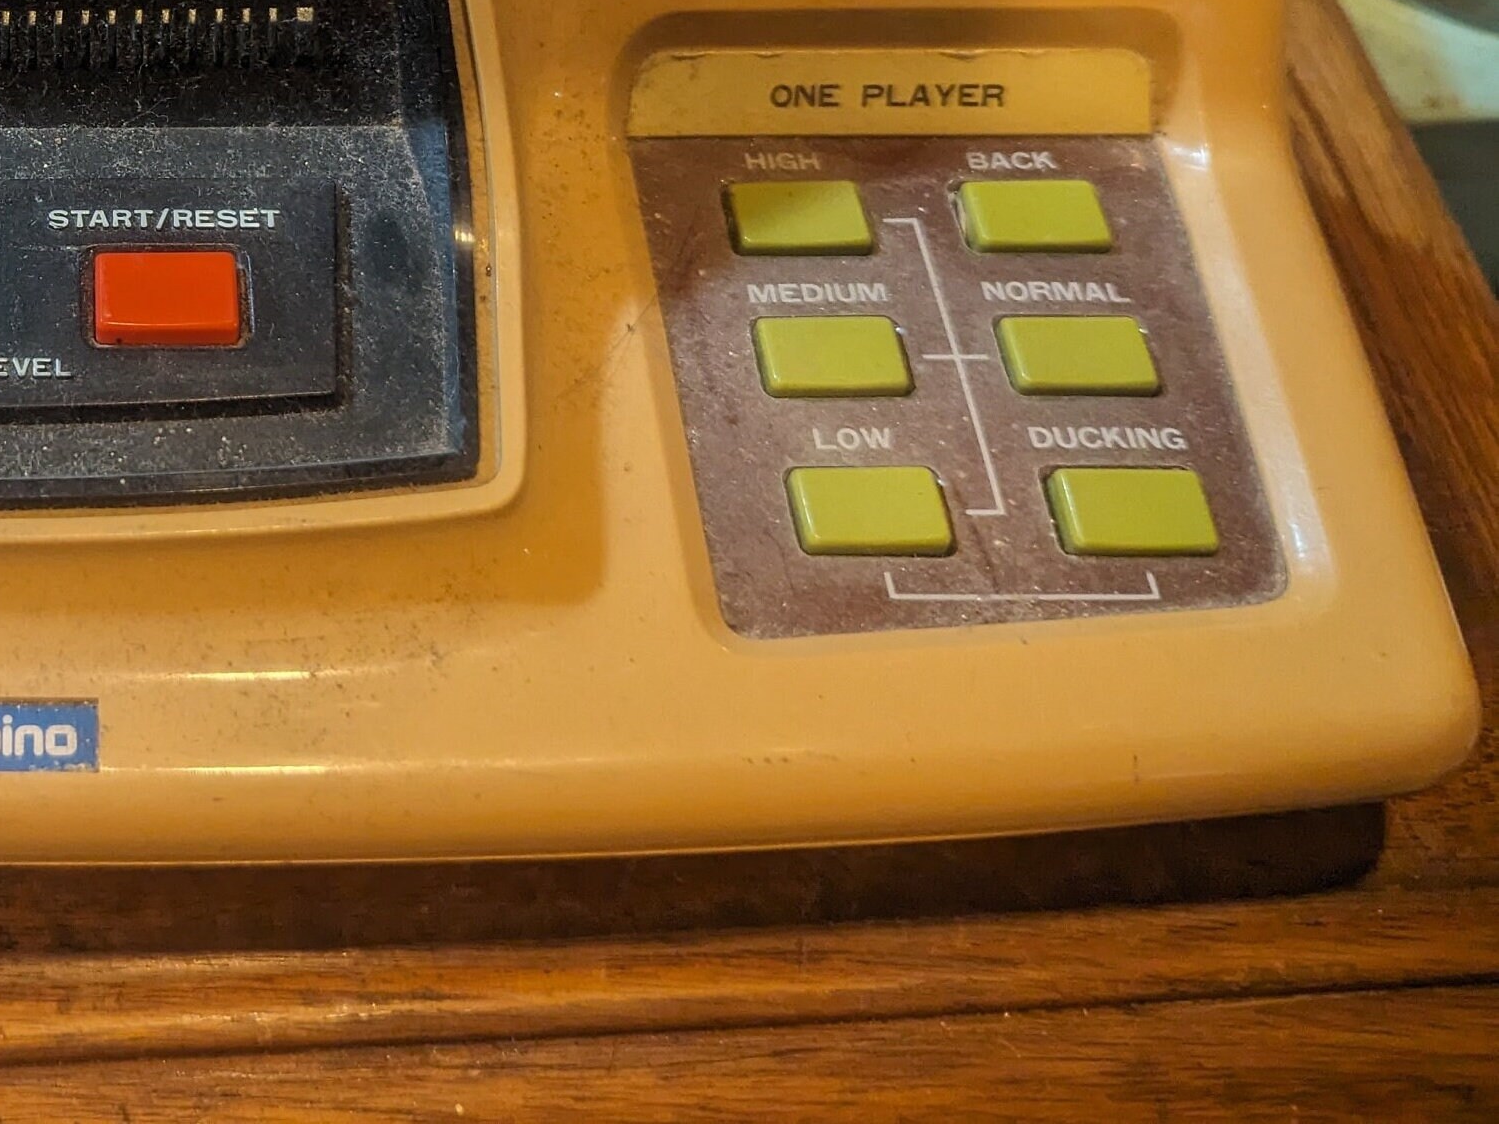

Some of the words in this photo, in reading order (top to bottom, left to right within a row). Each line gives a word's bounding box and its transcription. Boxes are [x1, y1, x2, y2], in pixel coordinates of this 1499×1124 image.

[770, 84, 841, 108] ONE
[861, 84, 1006, 108] PLAYER
[743, 151, 821, 172] HIGH
[966, 151, 1057, 171] BACK
[47, 208, 280, 230] START/RESET
[747, 283, 889, 304] MEDIUM
[981, 281, 1131, 304] NORMAL
[813, 428, 892, 451] LOW
[1027, 426, 1189, 451] DUCKING
